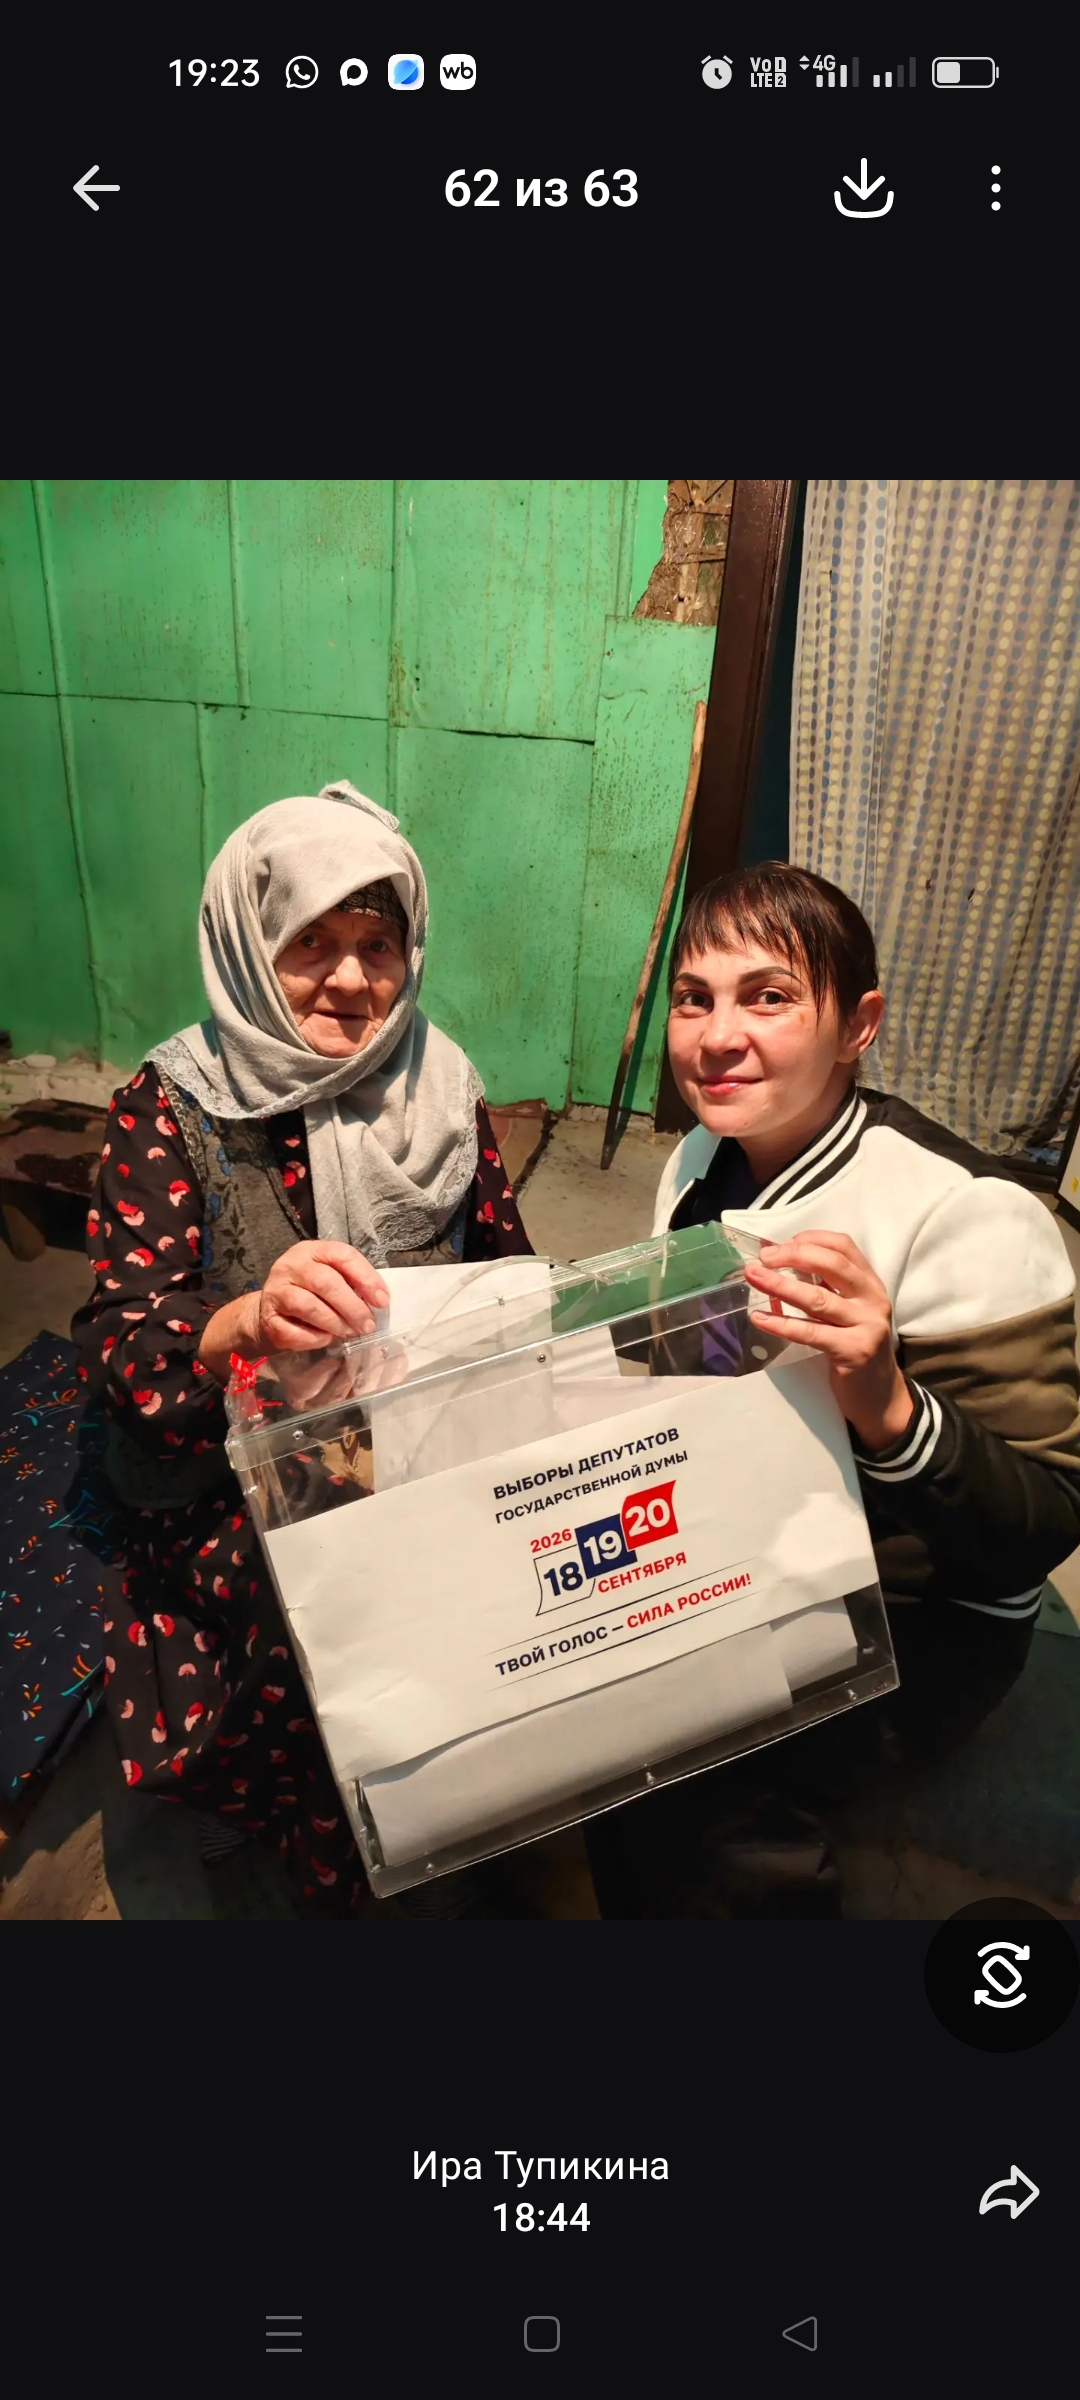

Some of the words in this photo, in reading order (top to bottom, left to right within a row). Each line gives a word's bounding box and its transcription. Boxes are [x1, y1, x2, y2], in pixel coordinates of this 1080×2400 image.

[493, 1463, 574, 1500] ВЫБОРЫ
[578, 1427, 680, 1473] ДЕПУТАТОВ
[495, 1466, 642, 1524] ГОСУДАРСТВЕННОЙ
[645, 1450, 688, 1476] ДУМЫ
[625, 1497, 670, 1537] 20
[530, 1528, 572, 1553] 2026
[583, 1529, 622, 1565] 19
[543, 1561, 583, 1597] 18
[597, 1551, 687, 1593] СЕНТЯБРЯ
[495, 1646, 546, 1676] ТВОЙ
[549, 1626, 608, 1657] ГОЛОС
[627, 1602, 674, 1628] СИЛА
[677, 1573, 751, 1611] РОССИИ!
